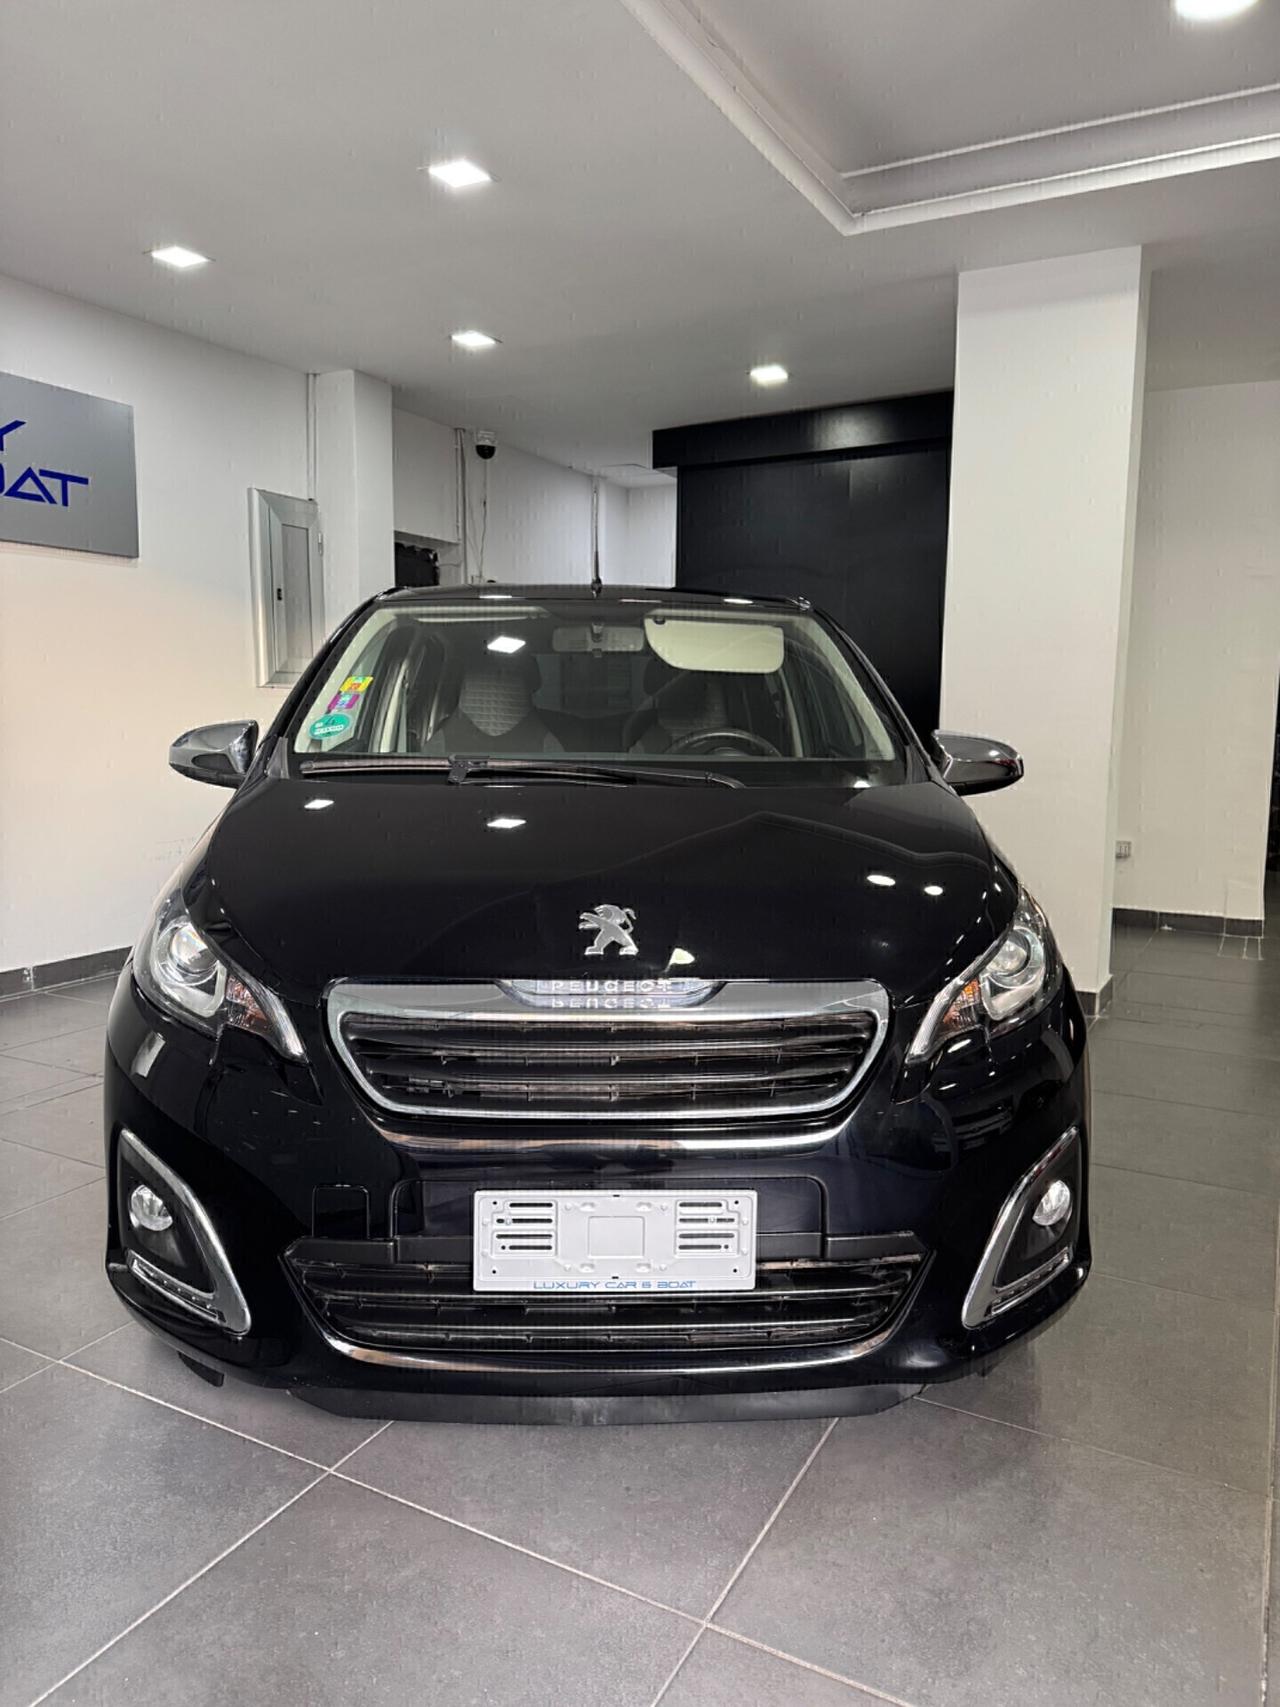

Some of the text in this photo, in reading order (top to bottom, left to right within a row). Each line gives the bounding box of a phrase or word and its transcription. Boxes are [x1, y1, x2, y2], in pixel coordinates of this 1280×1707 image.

[0, 462, 89, 507] AT
[551, 979, 672, 992] PEUGEOT
[533, 1281, 600, 1289] LUXURY
[605, 1281, 637, 1289] CAR
[657, 1280, 696, 1288] BOAT
